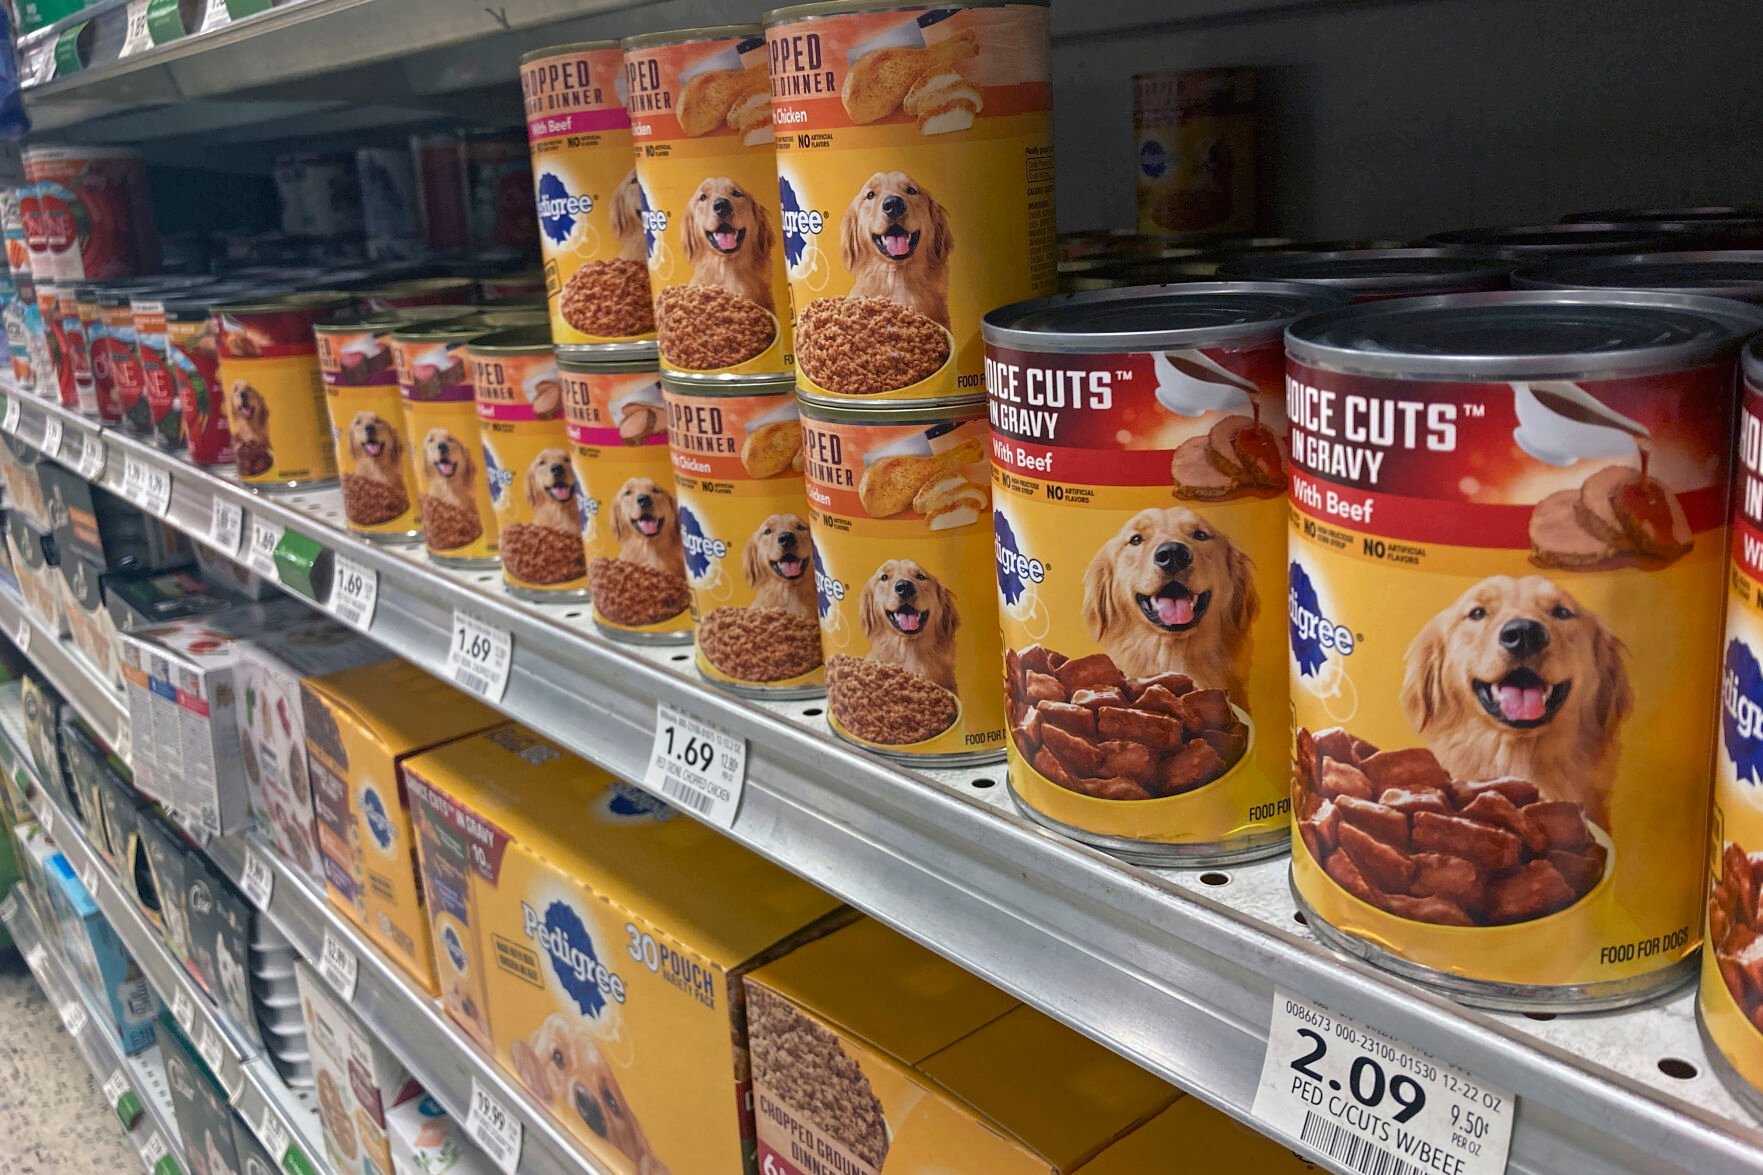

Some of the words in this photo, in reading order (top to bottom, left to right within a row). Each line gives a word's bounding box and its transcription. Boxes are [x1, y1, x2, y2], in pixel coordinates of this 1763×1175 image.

[547, 88, 603, 110] DINNER
[781, 72, 836, 96] DINNER
[548, 116, 572, 133] Beef
[777, 106, 808, 125] Chicken
[798, 134, 811, 149] NO
[957, 375, 979, 388] FOOD
[1027, 368, 1113, 411] CUTS
[989, 399, 999, 428] IN
[1000, 405, 1058, 439] GRAVY
[1345, 395, 1457, 452] CUTS
[683, 434, 735, 453] DINNER
[992, 438, 1013, 465] With
[1016, 448, 1053, 473] Beef
[1292, 427, 1304, 464] IN
[1306, 437, 1384, 484] GRAVY
[679, 456, 711, 474] Chicken
[1002, 472, 1011, 489] NO
[1047, 484, 1063, 501] NO
[1065, 487, 1094, 497] ARTIFICIAL
[1065, 495, 1089, 503] FLAVORS
[1293, 474, 1321, 510] With
[1326, 490, 1374, 524] Beef
[823, 513, 833, 528] NO
[1303, 518, 1316, 539] NO
[1363, 537, 1386, 559] NO
[1388, 543, 1426, 557] ARTIFICIAL
[1388, 553, 1420, 565] FLAVORS
[338, 567, 363, 598] 1.69
[459, 627, 491, 662] 1.69
[665, 726, 714, 772] 1.69
[965, 729, 984, 745] FOOD
[986, 727, 1001, 743] FOR
[683, 768, 708, 790] CHOPPED
[707, 780, 731, 802] CHICKEN
[1249, 804, 1275, 822] FOOD
[465, 814, 495, 849] GRAVY
[472, 843, 486, 867] 10
[521, 900, 627, 1005] Pedigree
[625, 922, 661, 974] 30
[660, 942, 715, 998] POUCH
[1601, 942, 1635, 965] FOOD
[1637, 938, 1660, 960] FOR
[1662, 926, 1689, 952] DOGS
[662, 970, 693, 997] VARIETY
[694, 991, 715, 1011] PACK
[1286, 1000, 1331, 1032] 0086673
[1336, 1023, 1437, 1082] 000-23100-01530
[1443, 1074, 1478, 1103] 12-22
[1483, 1092, 1502, 1114] OZ
[1290, 1027, 1427, 1124] 2.09
[759, 1094, 815, 1151] CHOPPED
[1292, 1076, 1323, 1106] PED
[1329, 1096, 1391, 1143] C/CUTS
[1397, 1128, 1466, 1175] W/BEEF
[1451, 1132, 1468, 1151] PER
[1468, 1142, 1482, 1157] OZ
